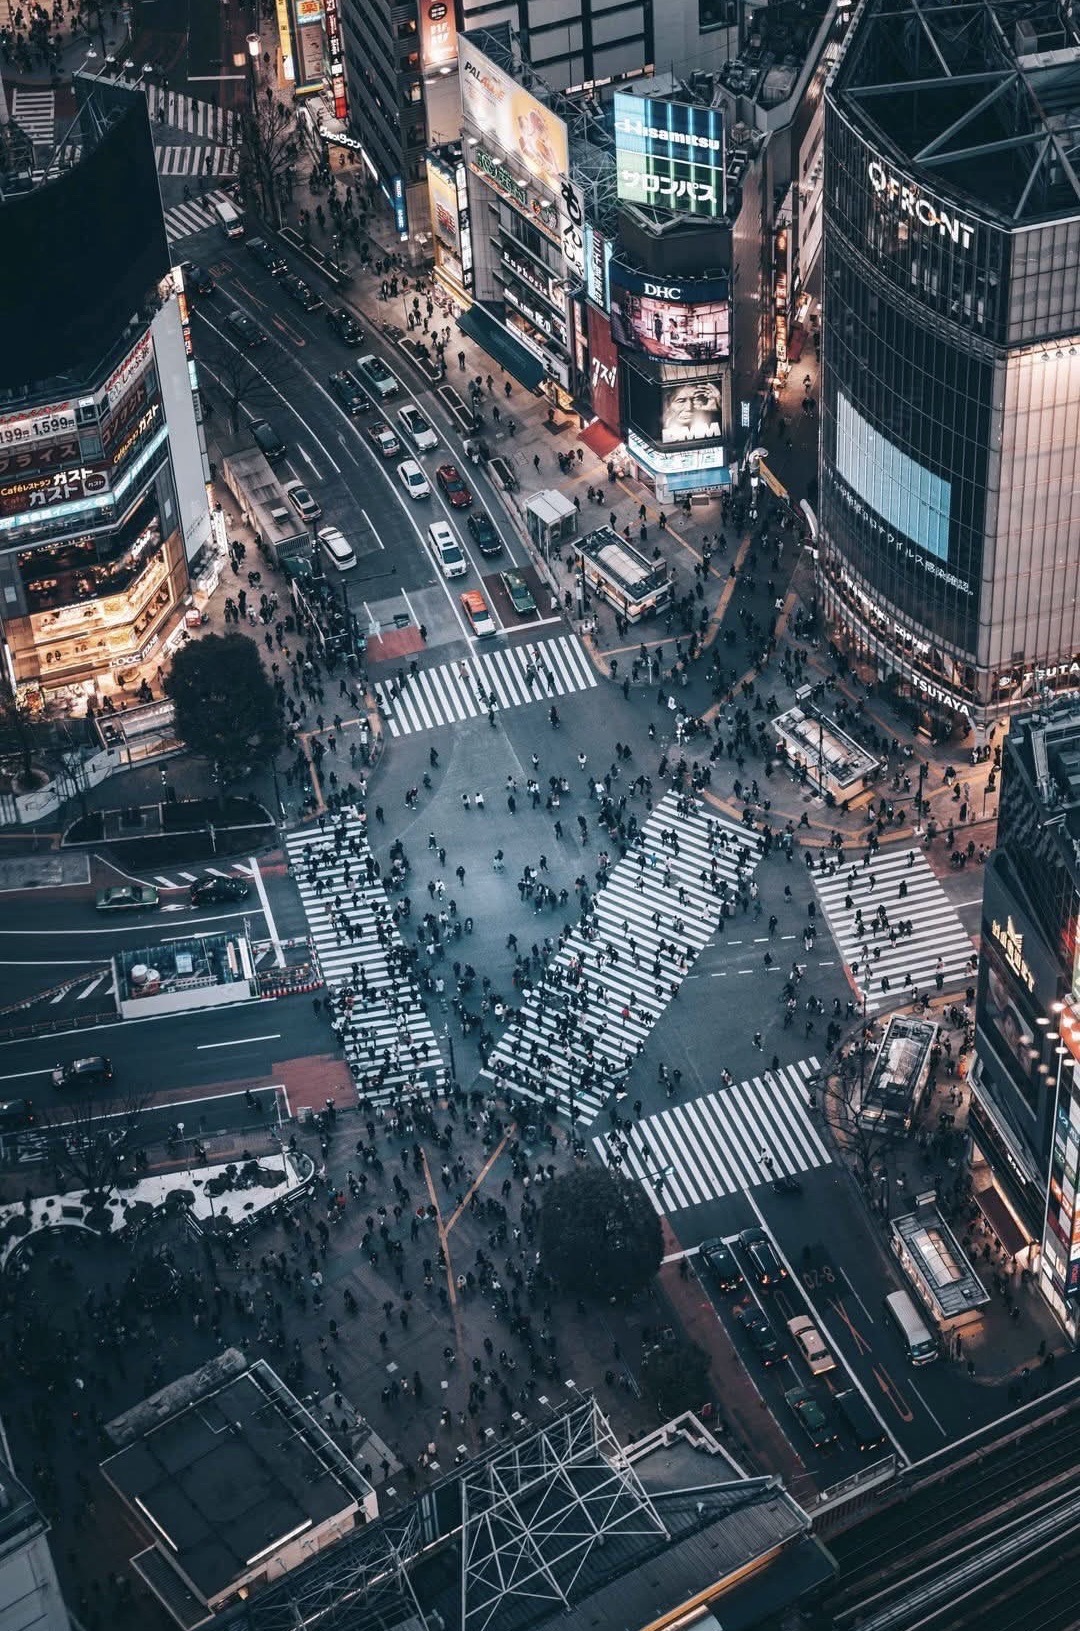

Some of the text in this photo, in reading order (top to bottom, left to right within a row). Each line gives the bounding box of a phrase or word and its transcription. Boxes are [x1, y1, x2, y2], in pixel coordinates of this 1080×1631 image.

[621, 170, 716, 204] サロンパス
[868, 162, 974, 249] QFRONT
[644, 283, 681, 299] DHC
[53, 467, 93, 486] ガスト
[29, 484, 78, 507] ガスト
[911, 674, 970, 716] TSUTAYA
